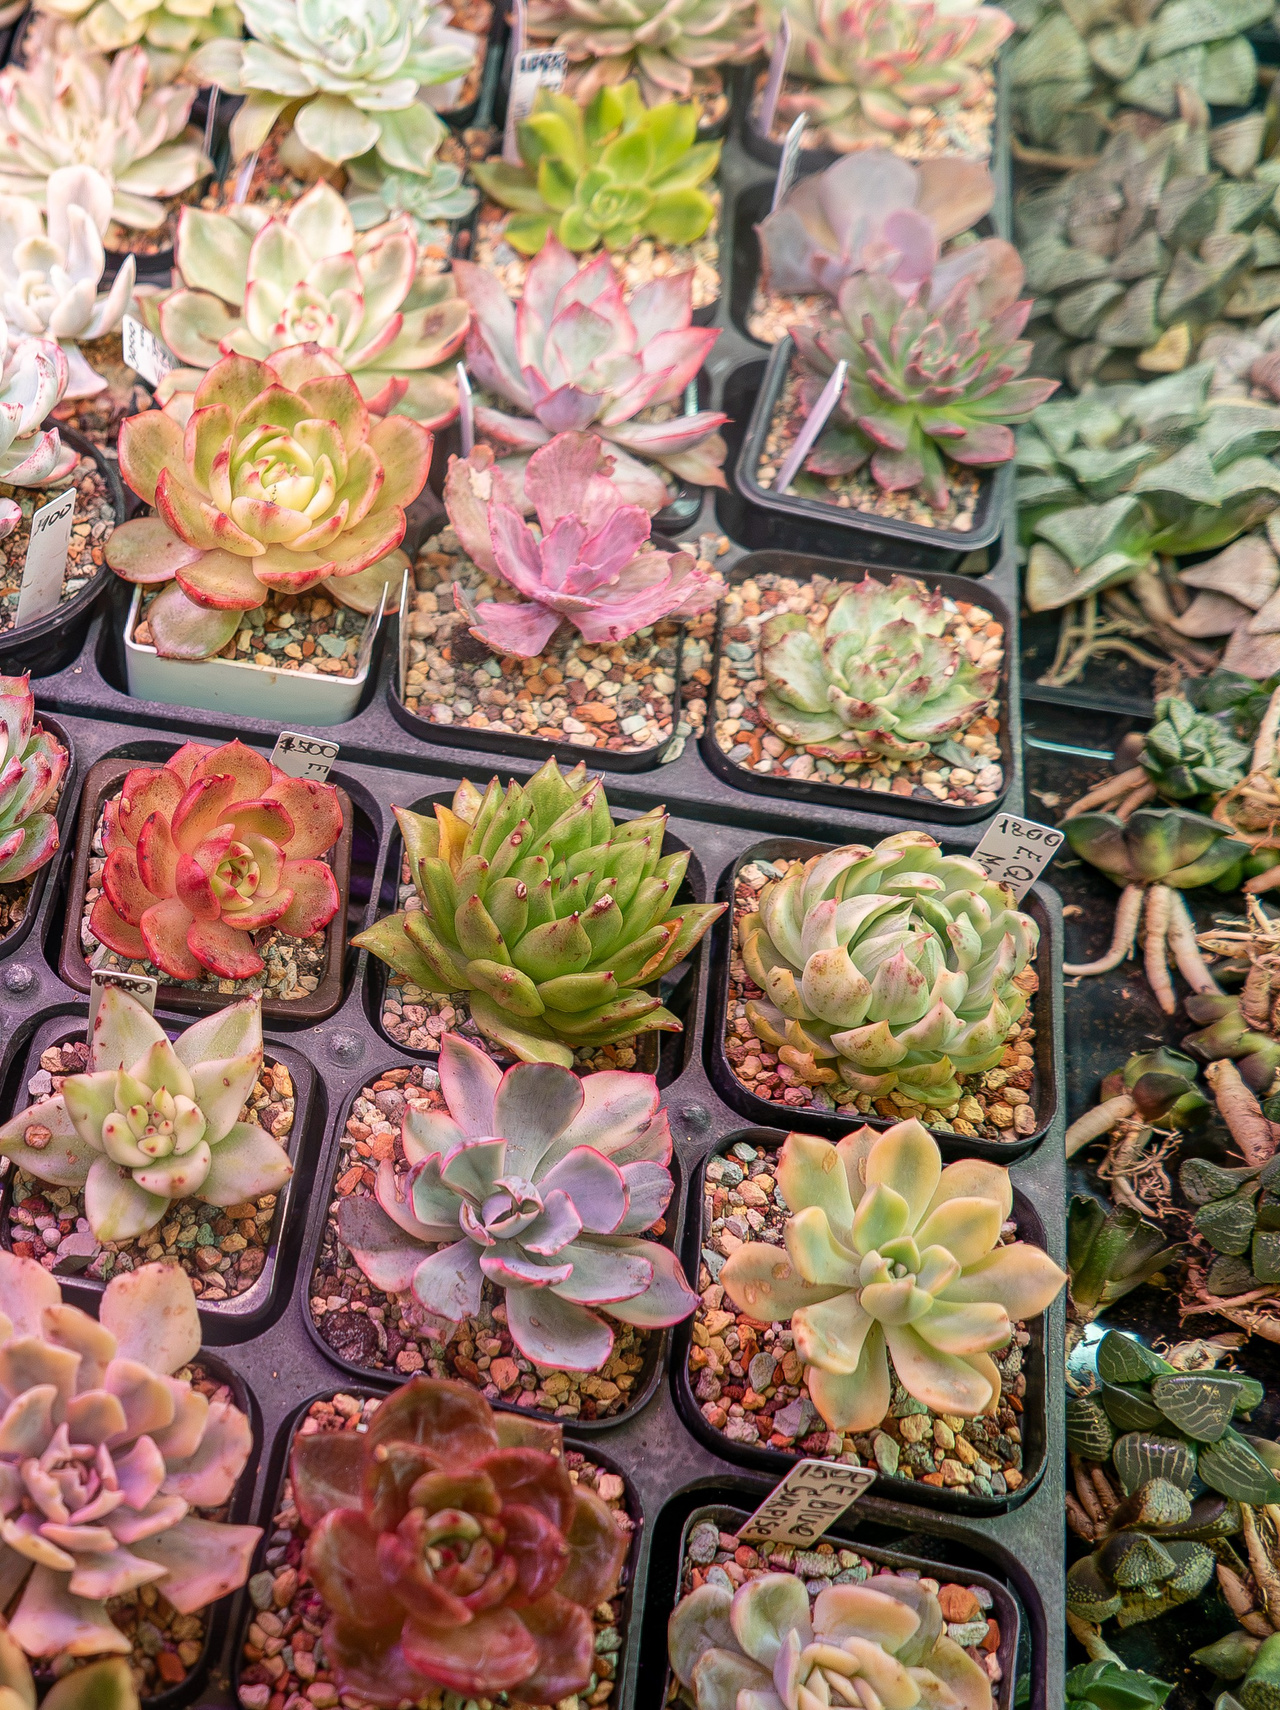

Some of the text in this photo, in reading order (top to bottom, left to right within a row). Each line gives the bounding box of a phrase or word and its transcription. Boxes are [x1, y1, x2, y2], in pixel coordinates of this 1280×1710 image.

[999, 819, 1060, 847] 1800
[799, 1464, 872, 1484] 1500
[788, 1499, 845, 1536] Blue
